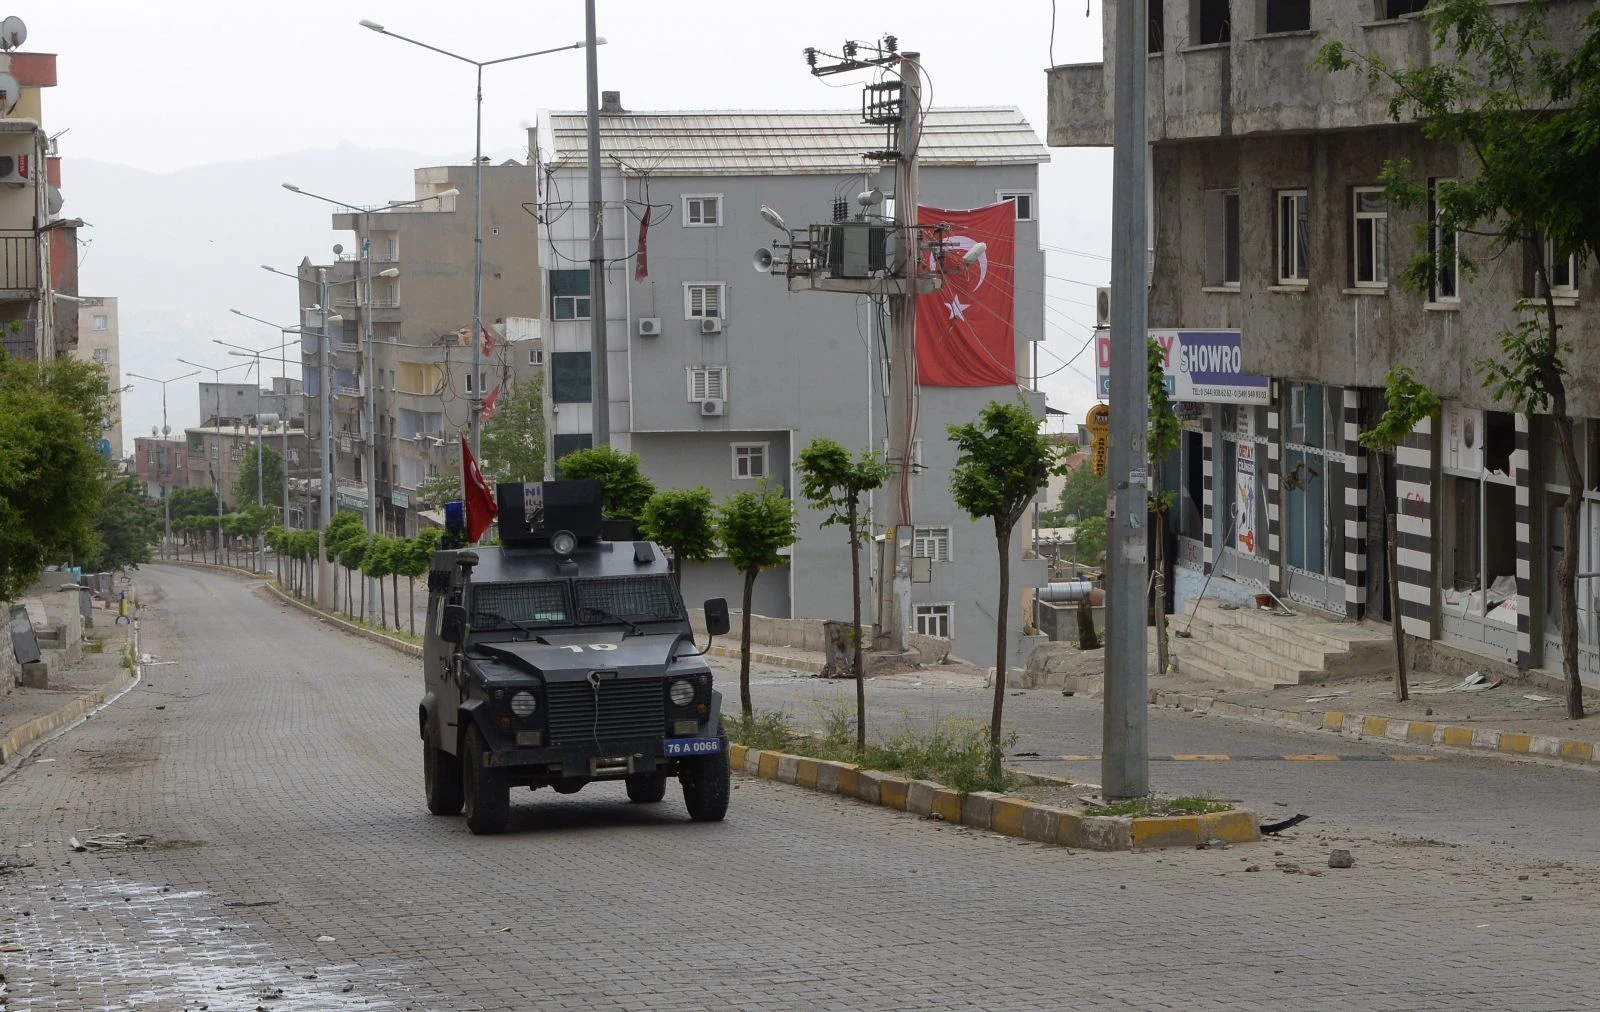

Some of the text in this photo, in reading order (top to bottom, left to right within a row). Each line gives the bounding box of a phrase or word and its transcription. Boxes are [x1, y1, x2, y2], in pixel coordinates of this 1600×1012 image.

[668, 742, 718, 754] 76 A 0066
